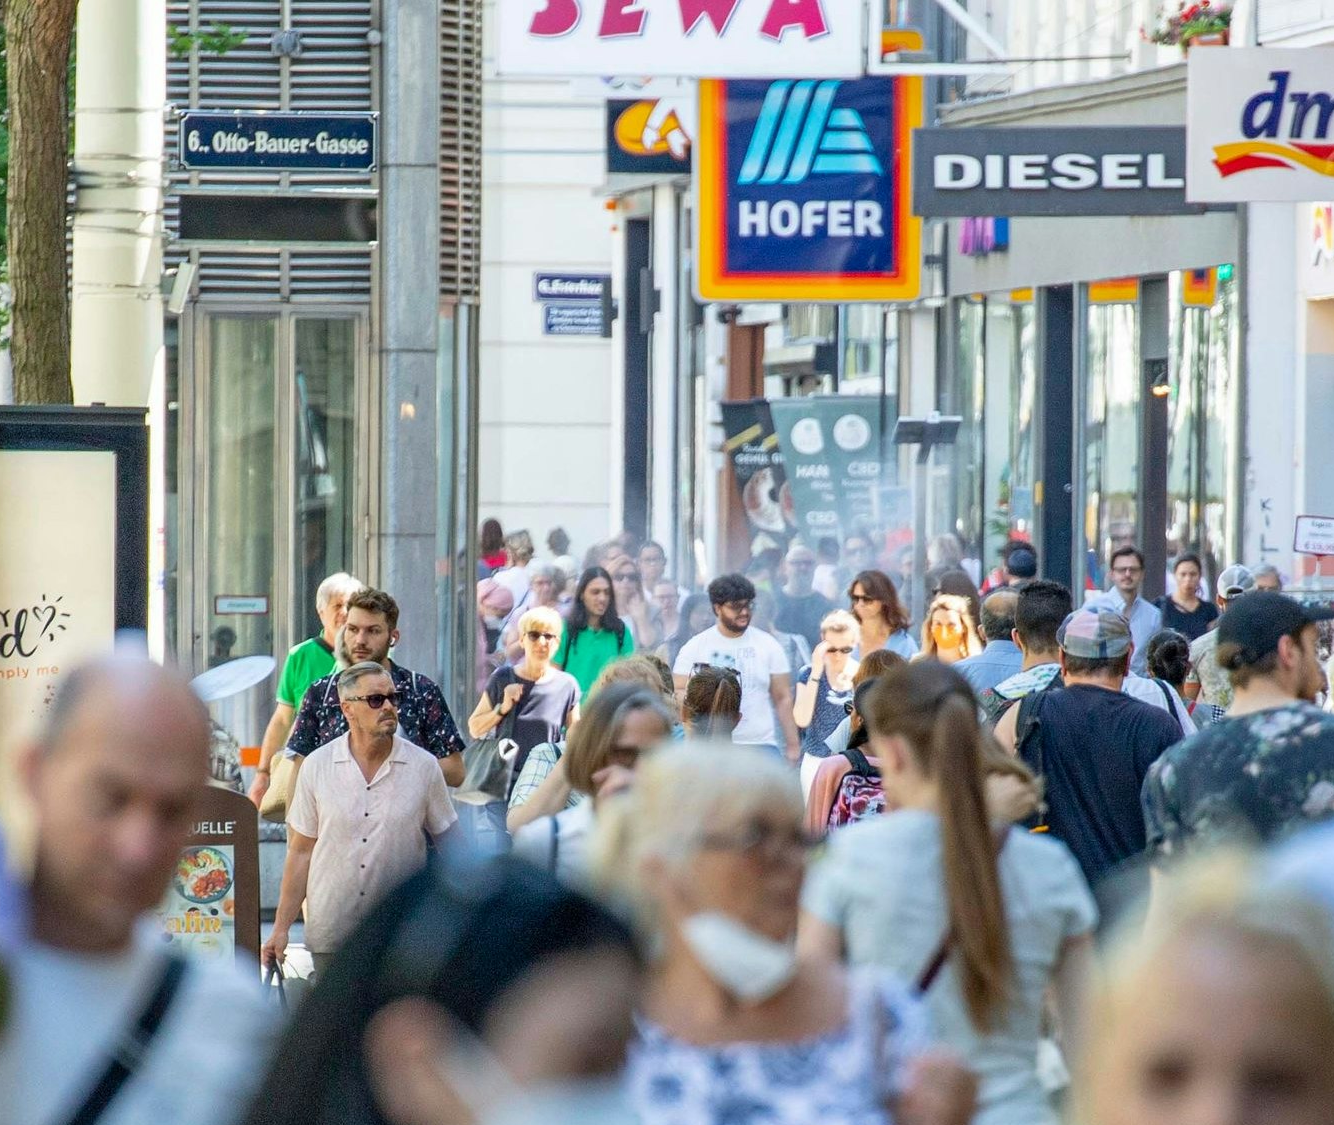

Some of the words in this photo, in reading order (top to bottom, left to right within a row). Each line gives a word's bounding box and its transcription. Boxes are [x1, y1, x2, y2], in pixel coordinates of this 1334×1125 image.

[212, 131, 369, 155] Otto-Bauer-Gasse
[933, 153, 1185, 190] DIESEL
[738, 199, 885, 237] HOFER
[37, 665, 59, 676] me
